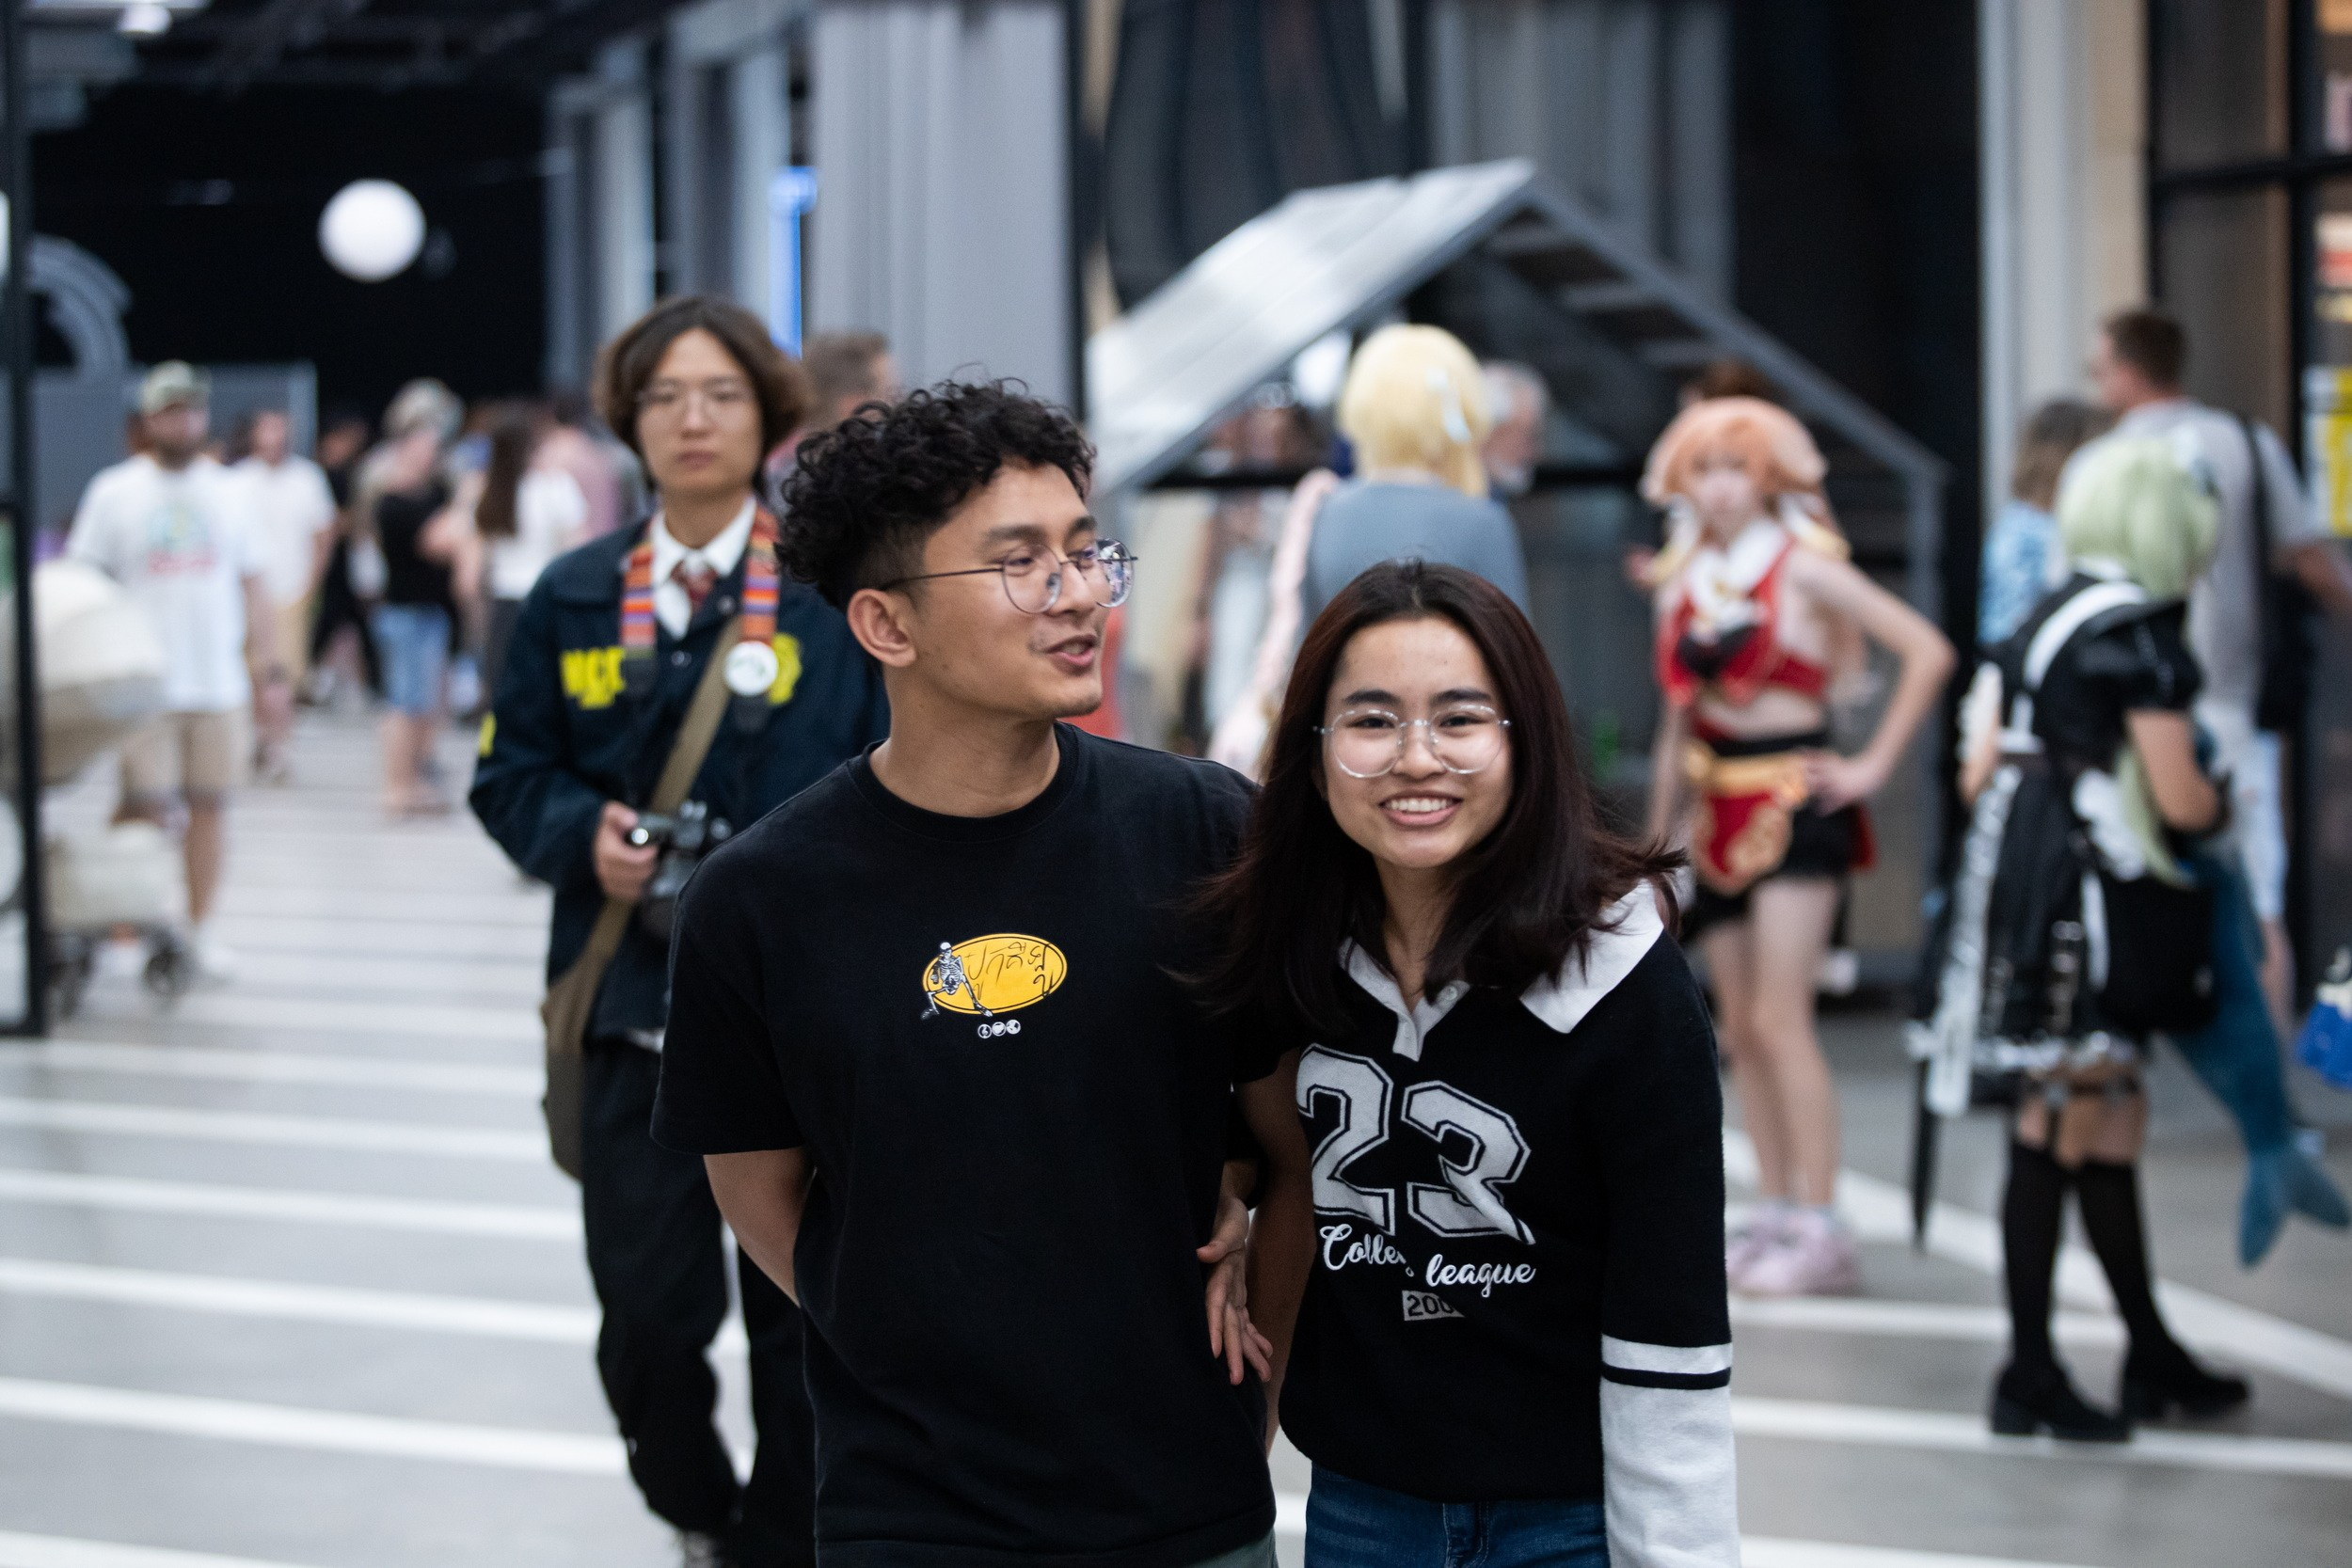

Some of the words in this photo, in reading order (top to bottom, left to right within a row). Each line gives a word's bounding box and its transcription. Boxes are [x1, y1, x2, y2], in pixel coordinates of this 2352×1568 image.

[1295, 1042, 1535, 1245] 23
[1320, 1224, 1414, 1277] Colle
[1425, 1253, 1536, 1298] league
[1406, 1293, 1455, 1318] 200
